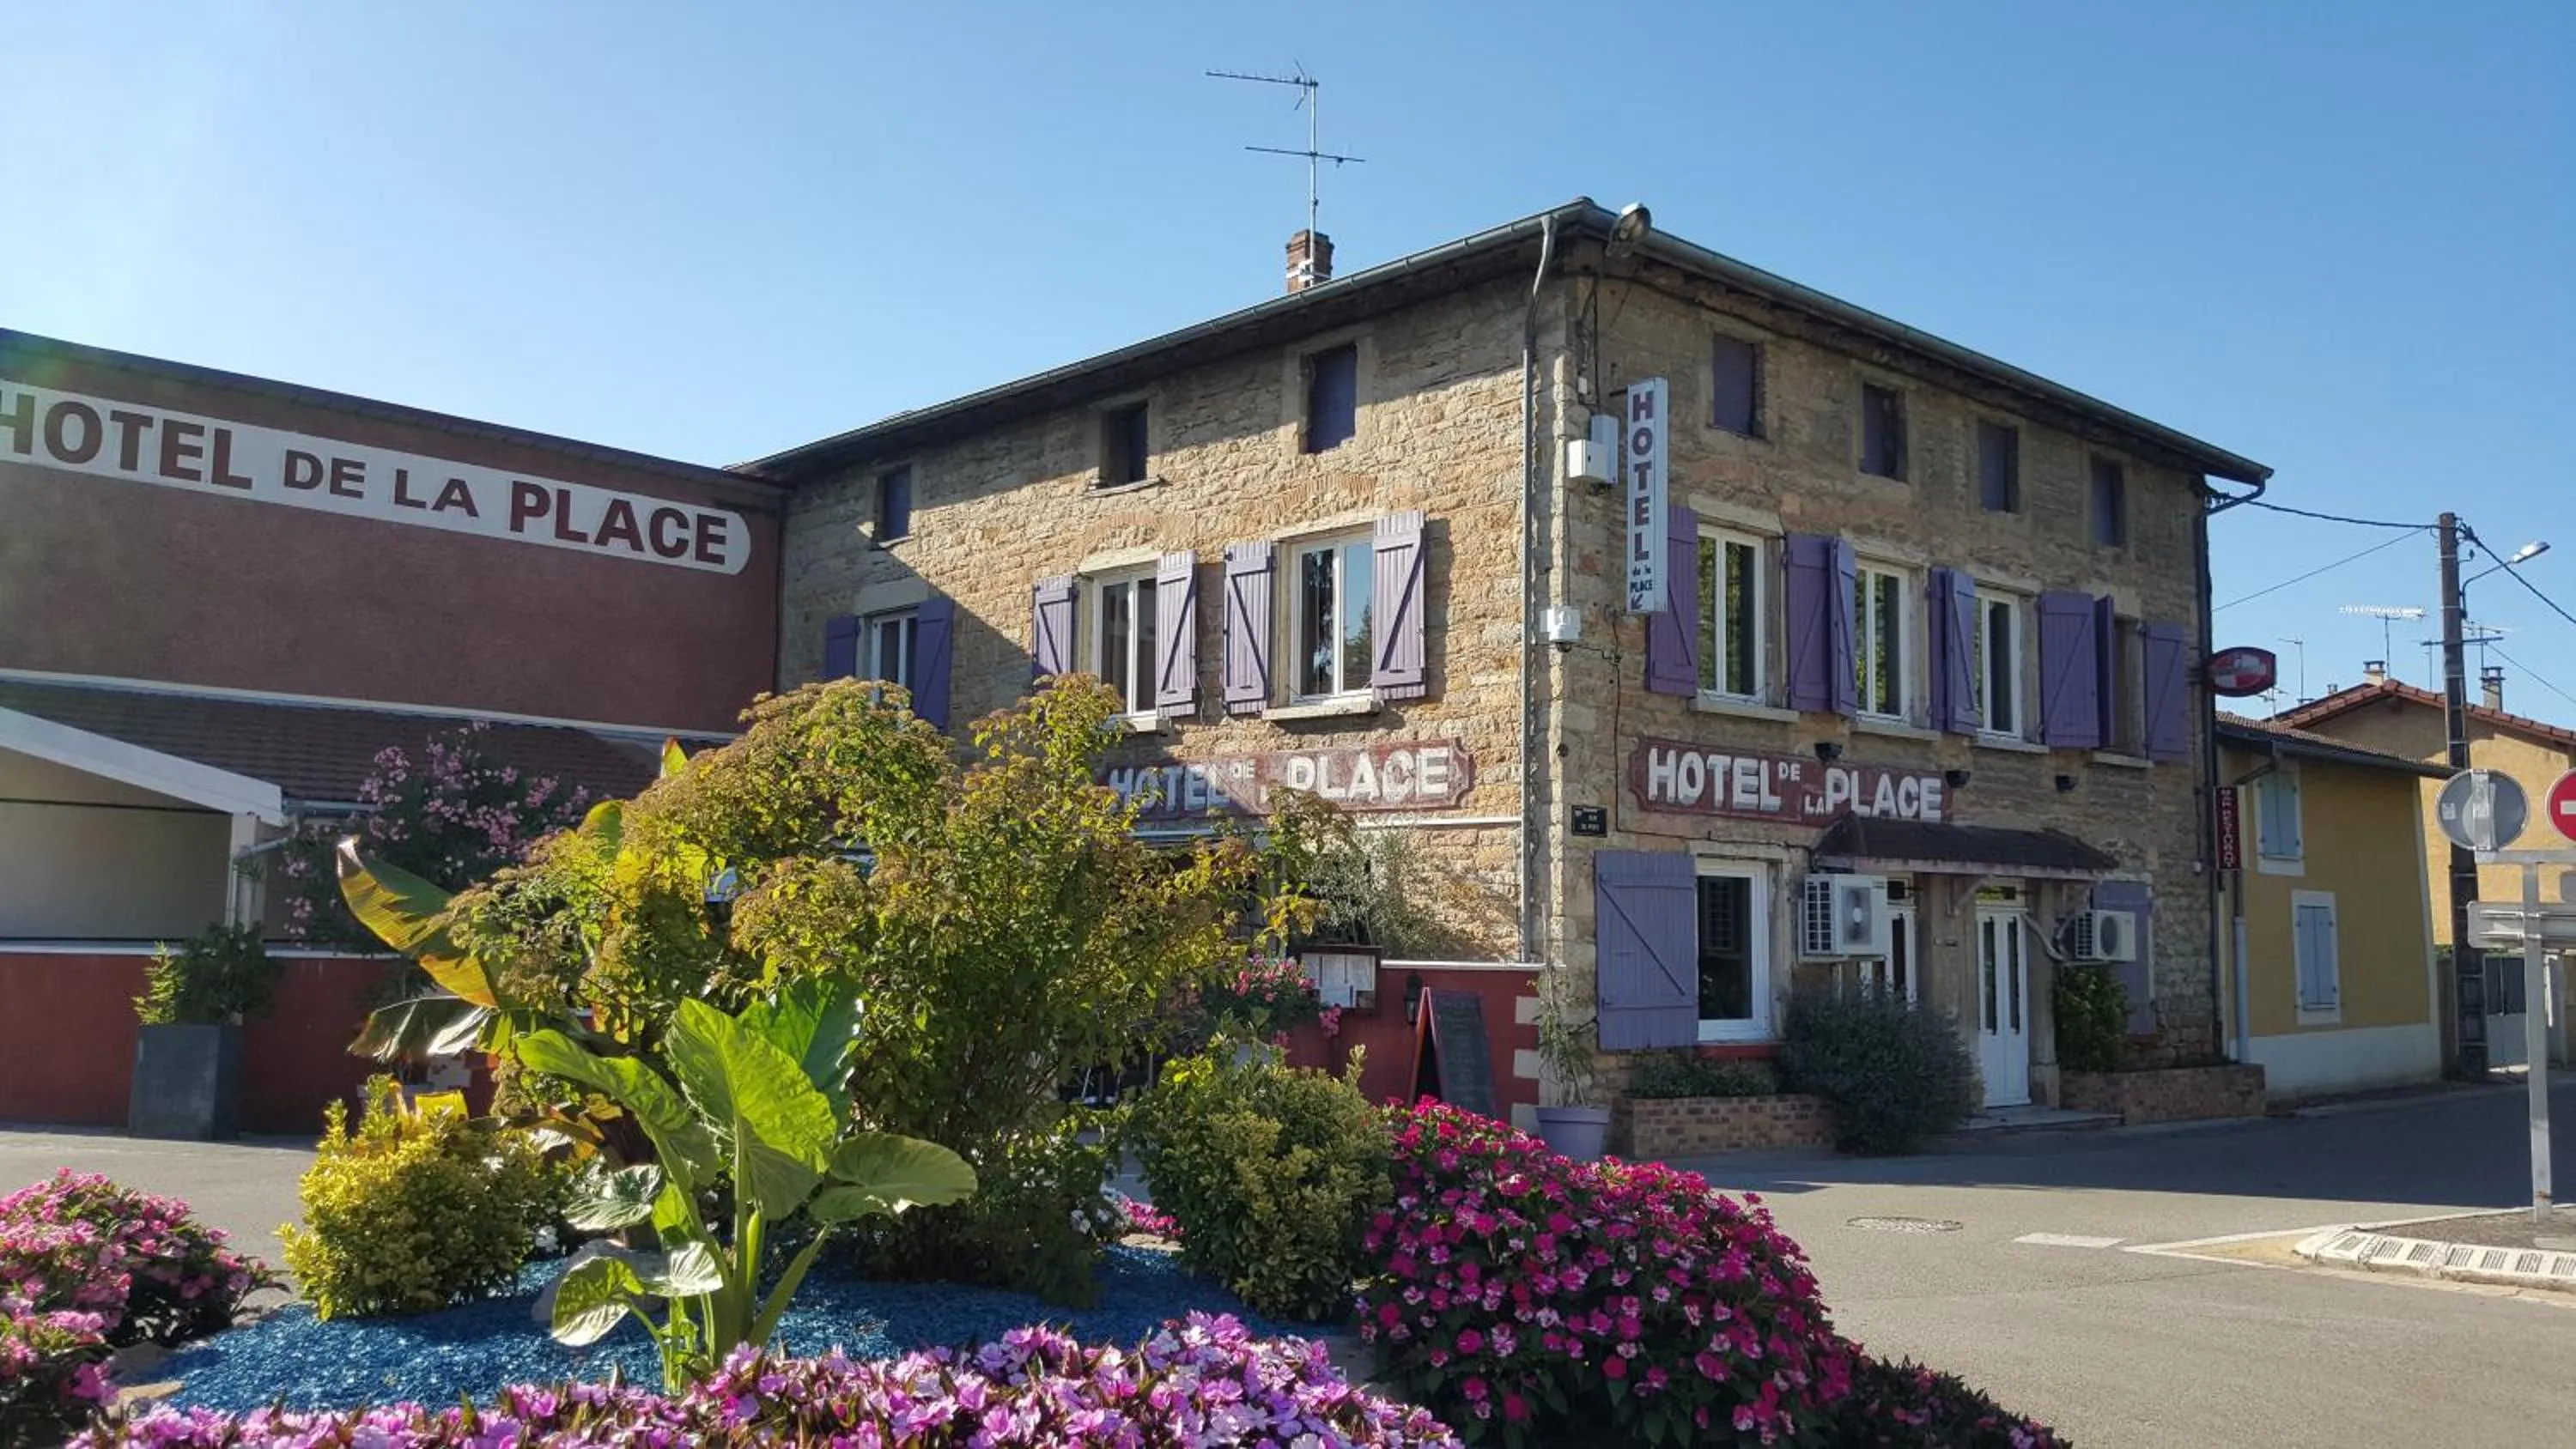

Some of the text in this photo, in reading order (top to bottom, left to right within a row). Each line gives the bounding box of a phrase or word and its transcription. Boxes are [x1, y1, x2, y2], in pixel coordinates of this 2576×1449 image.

[0, 390, 728, 565] HOTEL DE LA PLACE
[1632, 391, 1655, 561] HOTEL
[1230, 758, 1256, 779] DE
[1648, 748, 1942, 823] HOTEL DE LA PLACE
